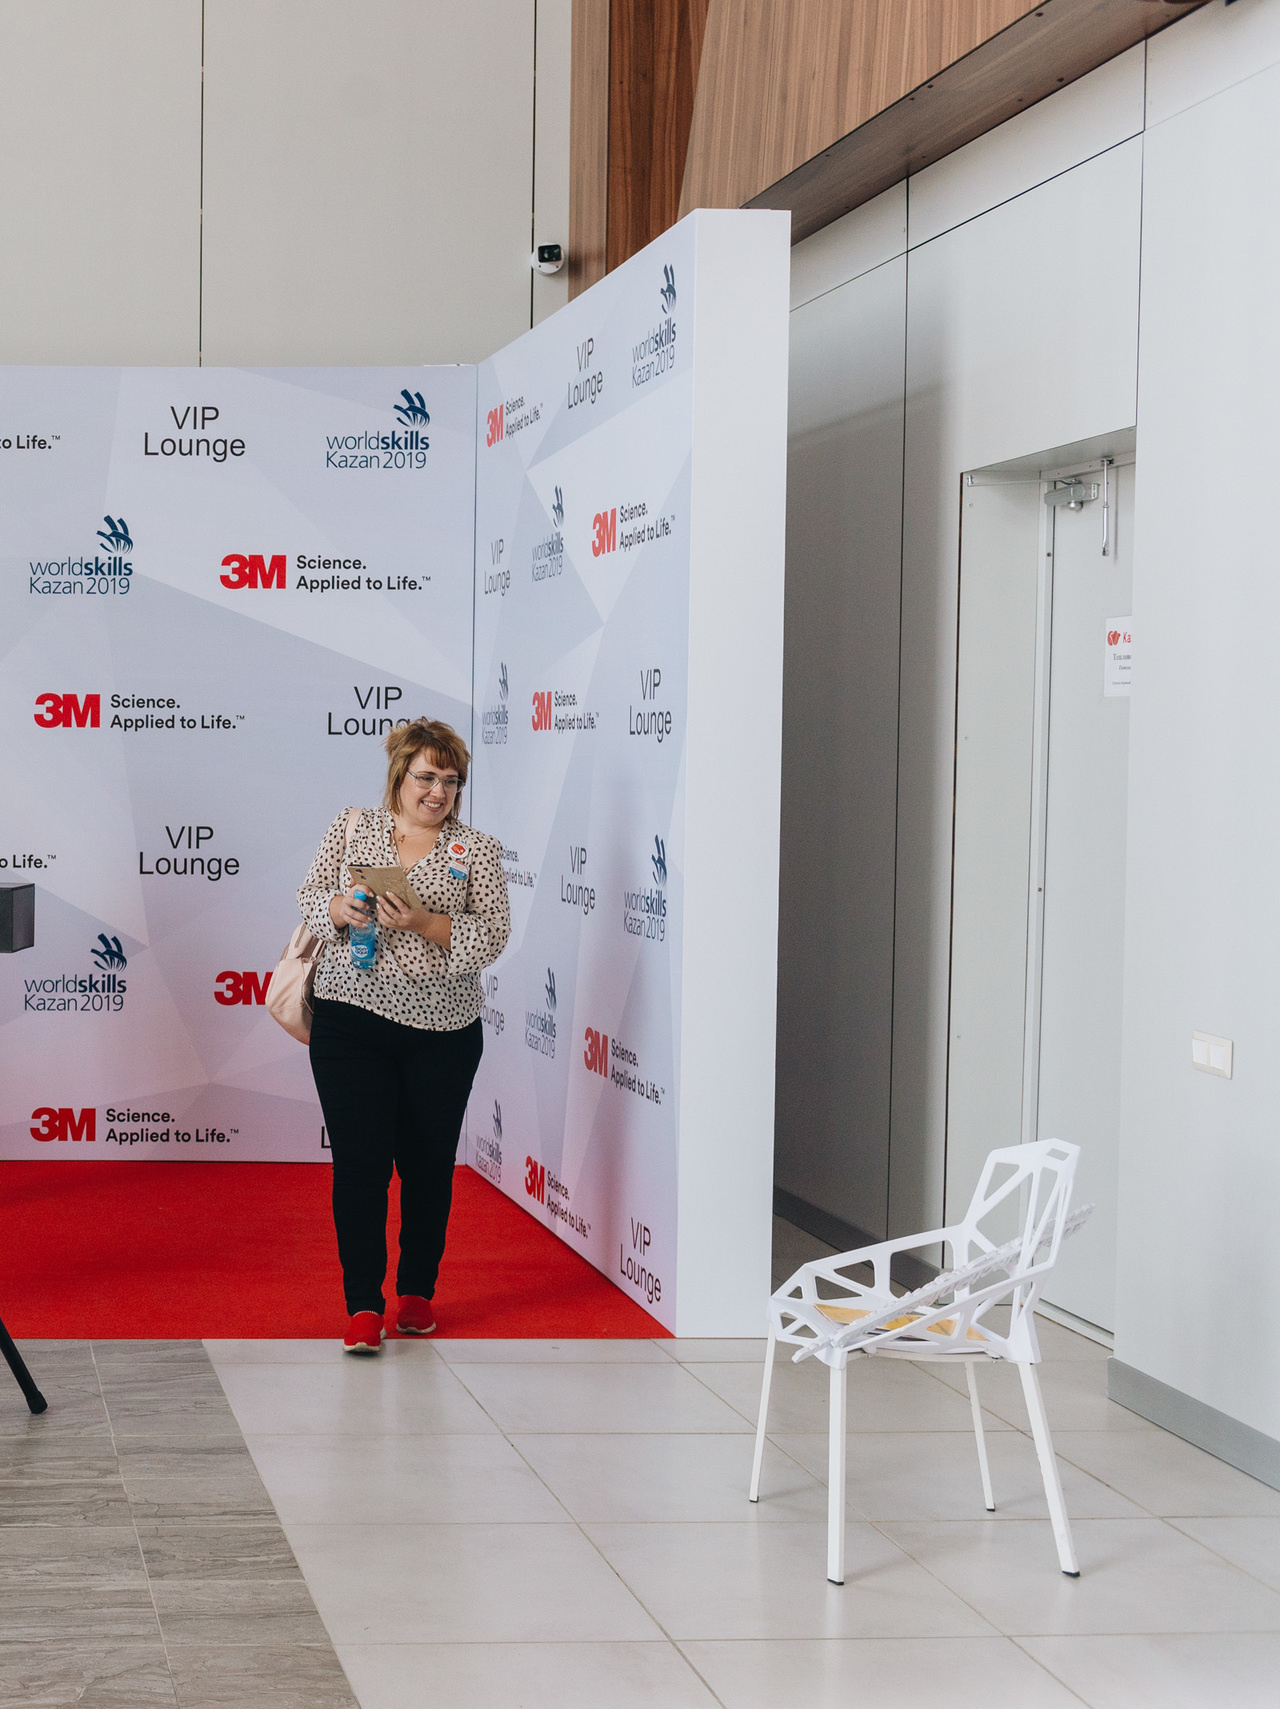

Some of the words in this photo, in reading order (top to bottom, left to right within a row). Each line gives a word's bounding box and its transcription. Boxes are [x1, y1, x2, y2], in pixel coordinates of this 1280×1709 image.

[577, 337, 594, 372] VIP
[632, 317, 676, 363] worldskills
[632, 361, 654, 388] Kazan
[655, 345, 675, 376] 2019
[568, 371, 603, 410] Lounge
[170, 406, 220, 430] VIP
[486, 403, 504, 448] 3M
[144, 433, 245, 462] Lounge
[326, 430, 430, 451] worldskills
[326, 451, 380, 469] Kazan
[383, 451, 427, 469] 2019
[620, 503, 648, 523] Science.
[592, 508, 616, 557] 3M
[619, 523, 645, 552] Applied
[647, 524, 654, 541] to
[297, 555, 367, 571] Science.
[491, 538, 504, 565] VIP
[29, 556, 133, 577] worldskills
[220, 554, 287, 590] 3M
[29, 576, 84, 595] Kazan
[86, 577, 130, 595] 2019
[296, 575, 362, 593] Applied
[366, 576, 383, 590] to
[484, 570, 510, 596] Lounge
[354, 686, 403, 710] VIP
[641, 668, 661, 700] VIP
[33, 693, 101, 729] 3M
[110, 694, 181, 709] Science.
[531, 691, 552, 731] 3M
[554, 691, 577, 707] Science.
[110, 714, 176, 732] Applied
[179, 714, 197, 729] to
[554, 713, 575, 734] Applied
[576, 715, 582, 730] to
[629, 705, 672, 743] Lounge
[165, 826, 214, 849] VIP
[139, 852, 240, 881] Lounge
[570, 846, 587, 875] VIP
[561, 875, 596, 915] Lounge
[624, 888, 667, 917] worldskills
[623, 911, 645, 936] Kazan
[646, 916, 665, 942] 2019
[24, 974, 127, 993] worldskills
[486, 972, 498, 1000] VIP
[24, 993, 78, 1012] Kazan
[80, 993, 124, 1012] 2019
[480, 1005, 504, 1036] ounge
[584, 1027, 608, 1078] 3M
[612, 1038, 638, 1067] Science.
[611, 1064, 636, 1092] Applied
[638, 1078, 645, 1096] to
[30, 1108, 96, 1142] 3M
[106, 1109, 176, 1124] Science.
[106, 1127, 170, 1145] Applied
[174, 1128, 192, 1143] to
[525, 1155, 545, 1205] 3M
[547, 1170, 570, 1200] Science.
[547, 1194, 567, 1219] Applied
[568, 1210, 575, 1228] to
[631, 1217, 651, 1256] VIP
[621, 1244, 661, 1304] Lounge
